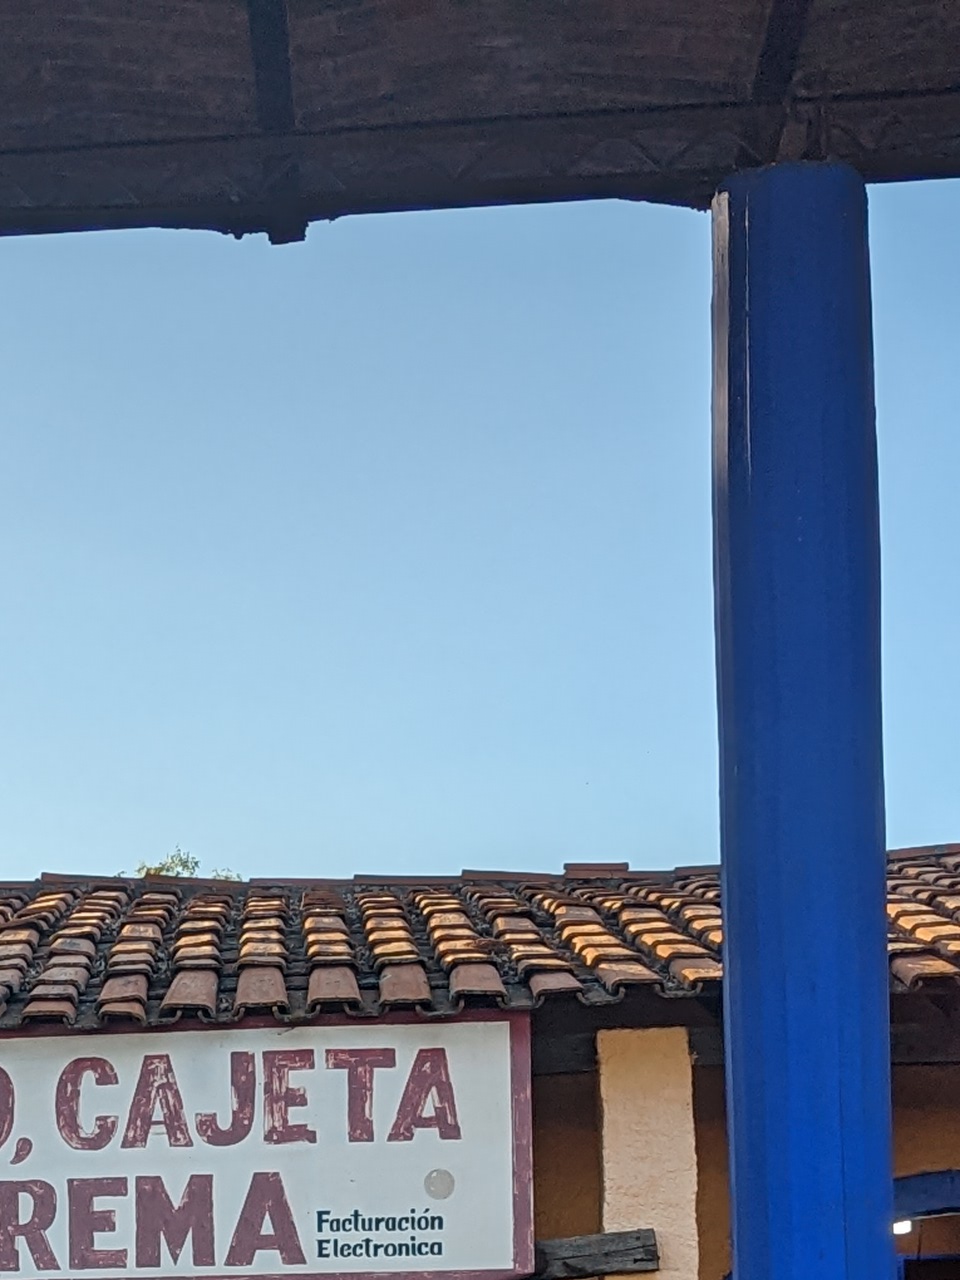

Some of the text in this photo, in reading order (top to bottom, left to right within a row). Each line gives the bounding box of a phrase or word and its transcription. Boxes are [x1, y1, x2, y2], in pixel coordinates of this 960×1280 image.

[55, 1047, 462, 1150] CAJETA
[315, 1208, 444, 1233] Facturación
[315, 1236, 444, 1258] Electronica
